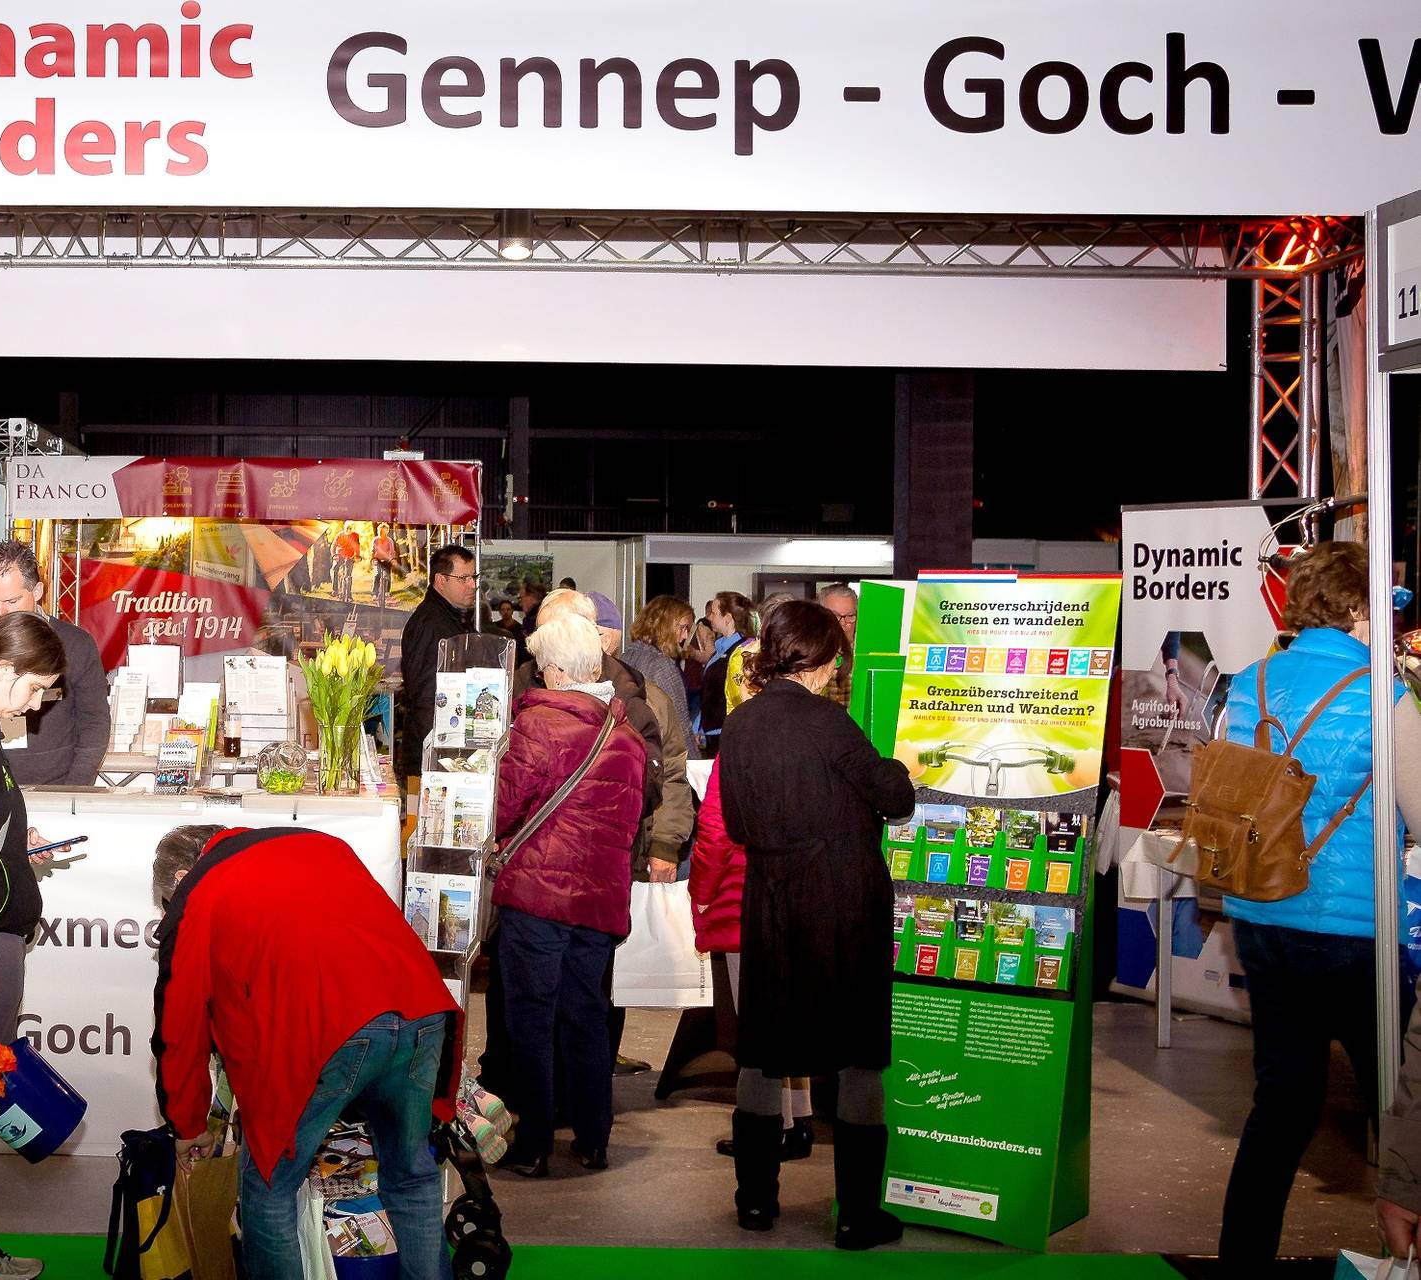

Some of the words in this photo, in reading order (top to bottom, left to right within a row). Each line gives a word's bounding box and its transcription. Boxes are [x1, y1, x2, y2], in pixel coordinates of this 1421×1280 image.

[326, 32, 800, 155] Gennep
[924, 32, 1229, 135] Goch
[16, 464, 45, 479] DA
[16, 484, 107, 499] FRANCO
[1133, 539, 1242, 575] Dynamic
[1133, 573, 1229, 600] Borders
[112, 590, 212, 613] Tradition
[939, 600, 1090, 614] Grensoverschrijdend
[194, 616, 243, 639] 1914
[940, 614, 989, 625] fietsen
[992, 616, 1010, 625] en
[1013, 616, 1085, 627] wandelen
[927, 685, 1079, 701] Grenzüberschreitend
[909, 700, 983, 713] Radfahren
[987, 704, 1015, 714] und
[1018, 704, 1095, 716] Wandern?
[1131, 714, 1202, 730] Agrobusiness
[36, 917, 163, 949] xmee
[18, 1012, 132, 1056] Goch
[906, 1073, 920, 1082] Alle
[926, 1095, 940, 1104] Alle
[897, 1126, 1042, 1156] www.dynamicborders.eu
